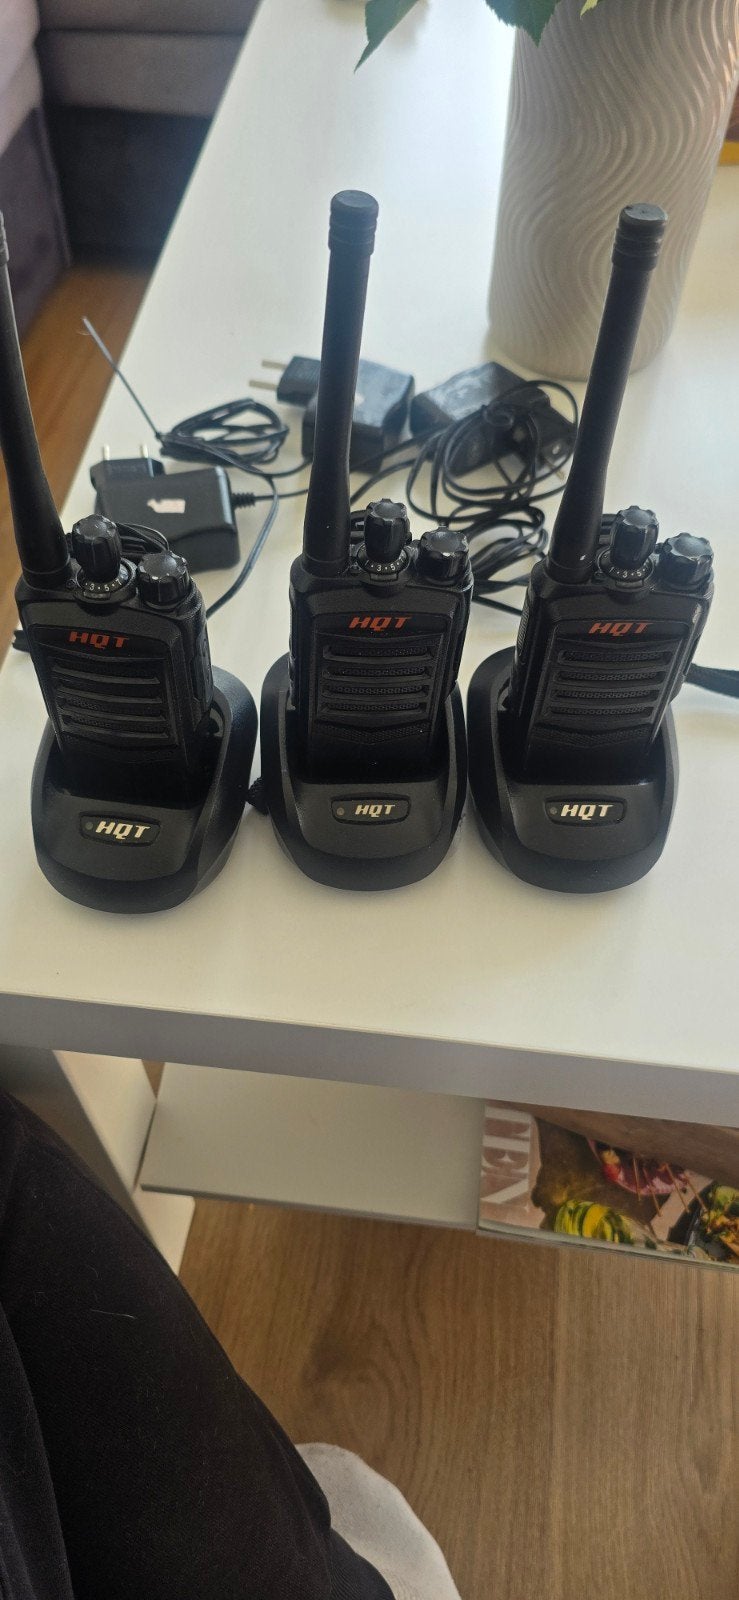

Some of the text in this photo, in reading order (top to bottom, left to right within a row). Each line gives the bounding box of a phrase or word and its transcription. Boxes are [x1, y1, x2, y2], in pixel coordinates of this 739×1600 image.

[390, 563, 396, 571] 5
[90, 583, 95, 591] 3
[104, 584, 110, 592] 5
[349, 616, 412, 632] HQT
[588, 622, 653, 637] HQT
[69, 631, 130, 649] HQT
[354, 804, 396, 818] HQT
[560, 804, 614, 821] HQT
[95, 820, 151, 840] HQT
